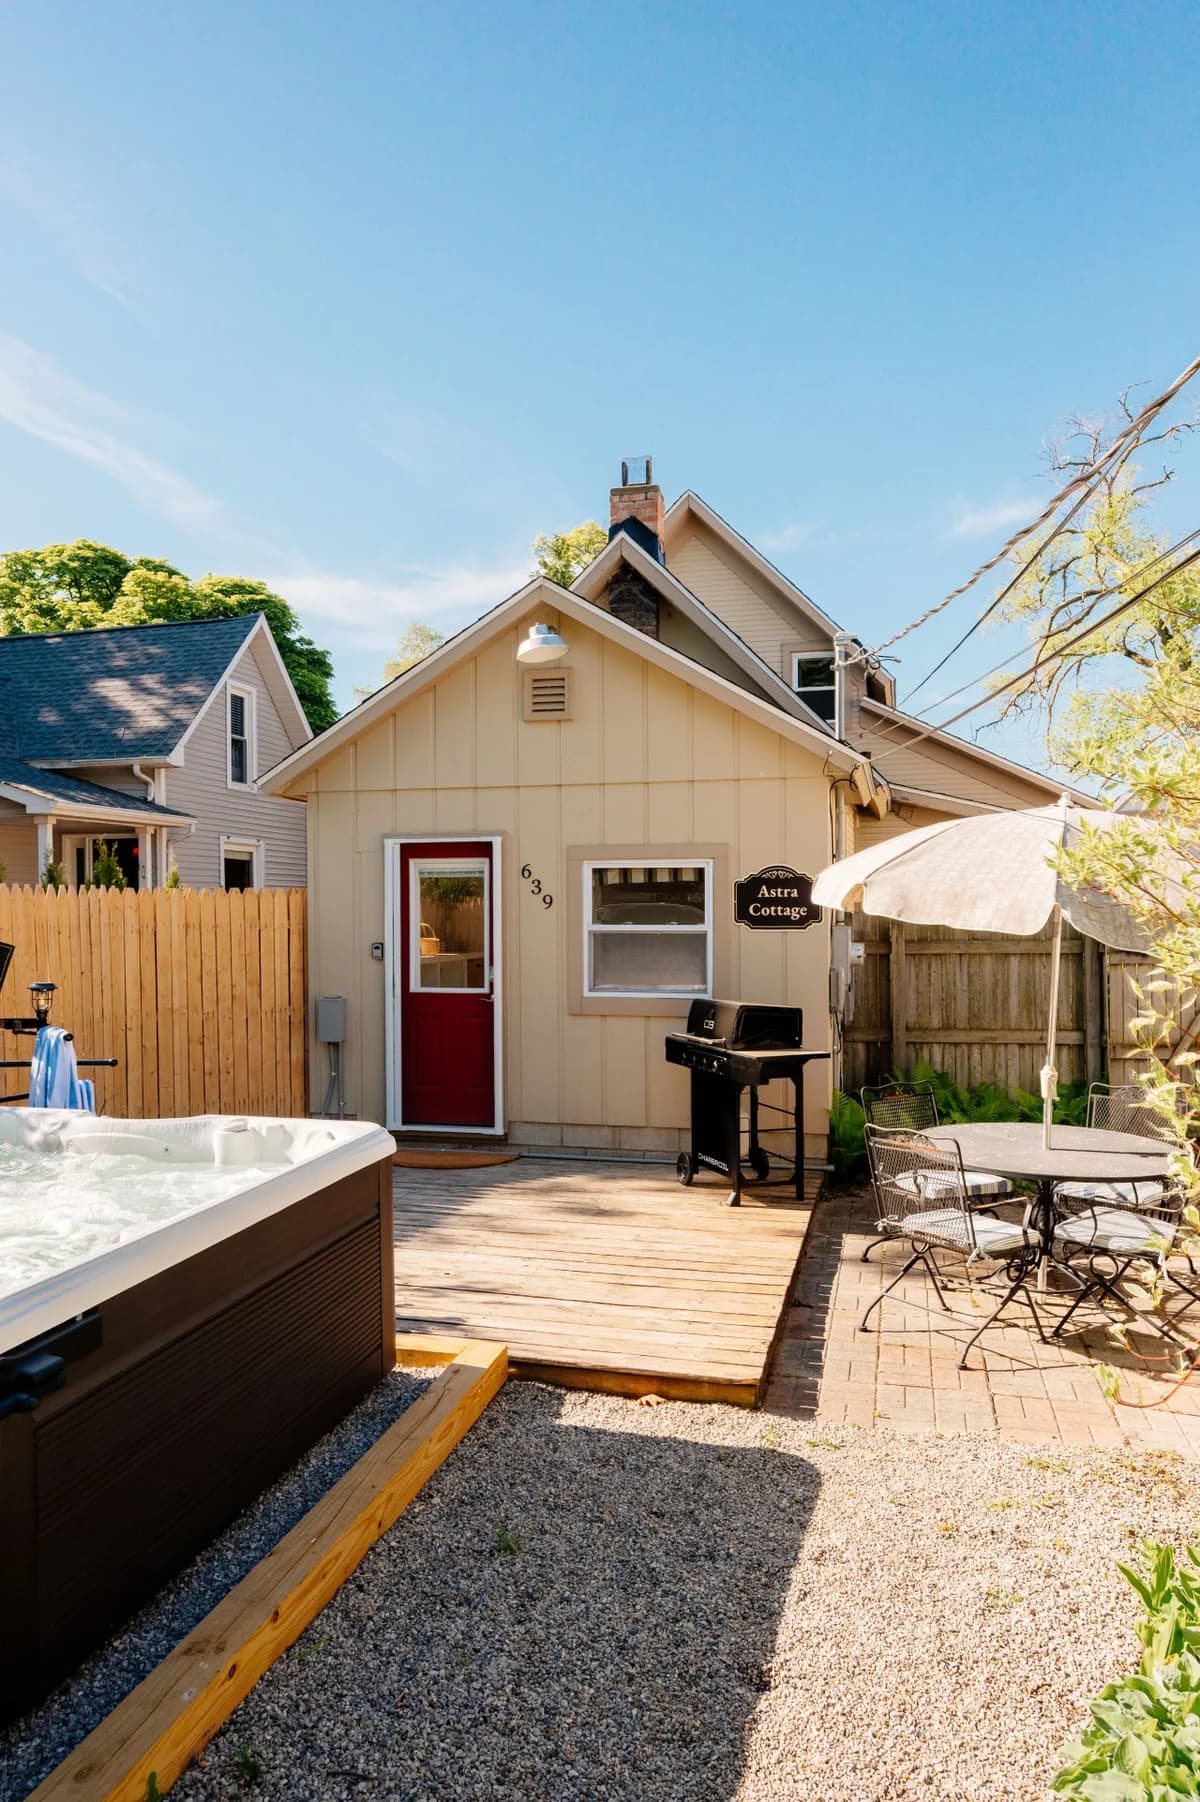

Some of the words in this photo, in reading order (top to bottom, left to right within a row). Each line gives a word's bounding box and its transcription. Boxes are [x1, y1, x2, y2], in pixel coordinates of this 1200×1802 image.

[521, 863, 553, 910] 639
[757, 885, 798, 898] Astra
[748, 903, 807, 920] Cottage
